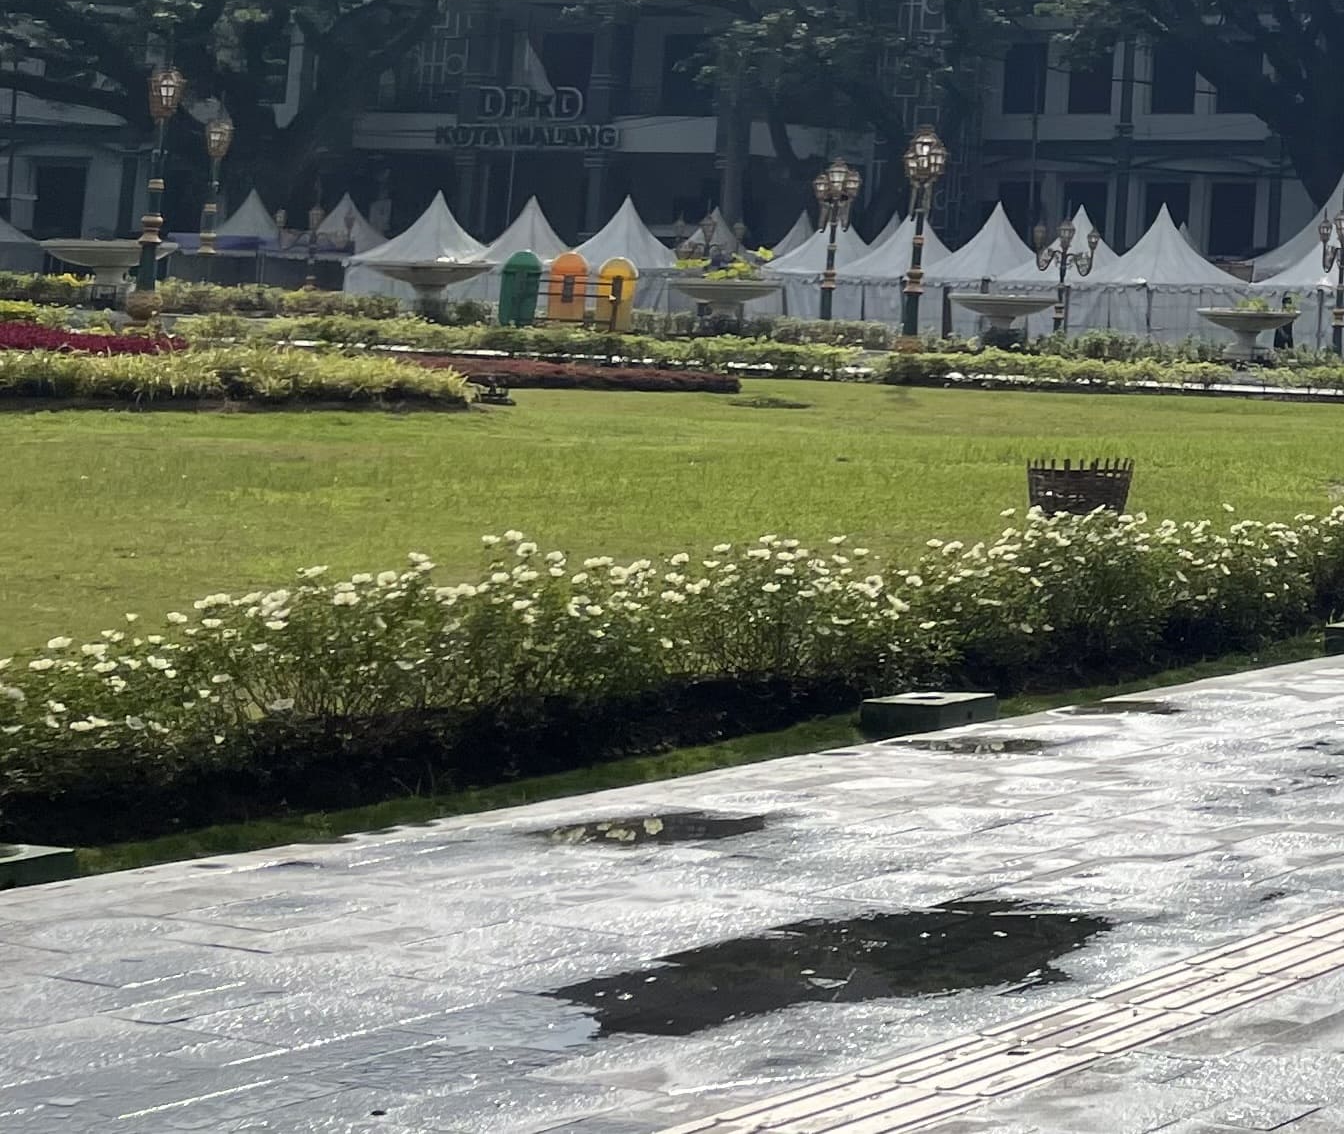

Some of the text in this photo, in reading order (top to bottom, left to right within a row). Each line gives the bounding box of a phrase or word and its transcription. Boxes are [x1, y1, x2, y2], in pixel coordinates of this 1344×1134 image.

[478, 86, 583, 121] DPRD
[435, 123, 620, 149] KOTA MALANG
